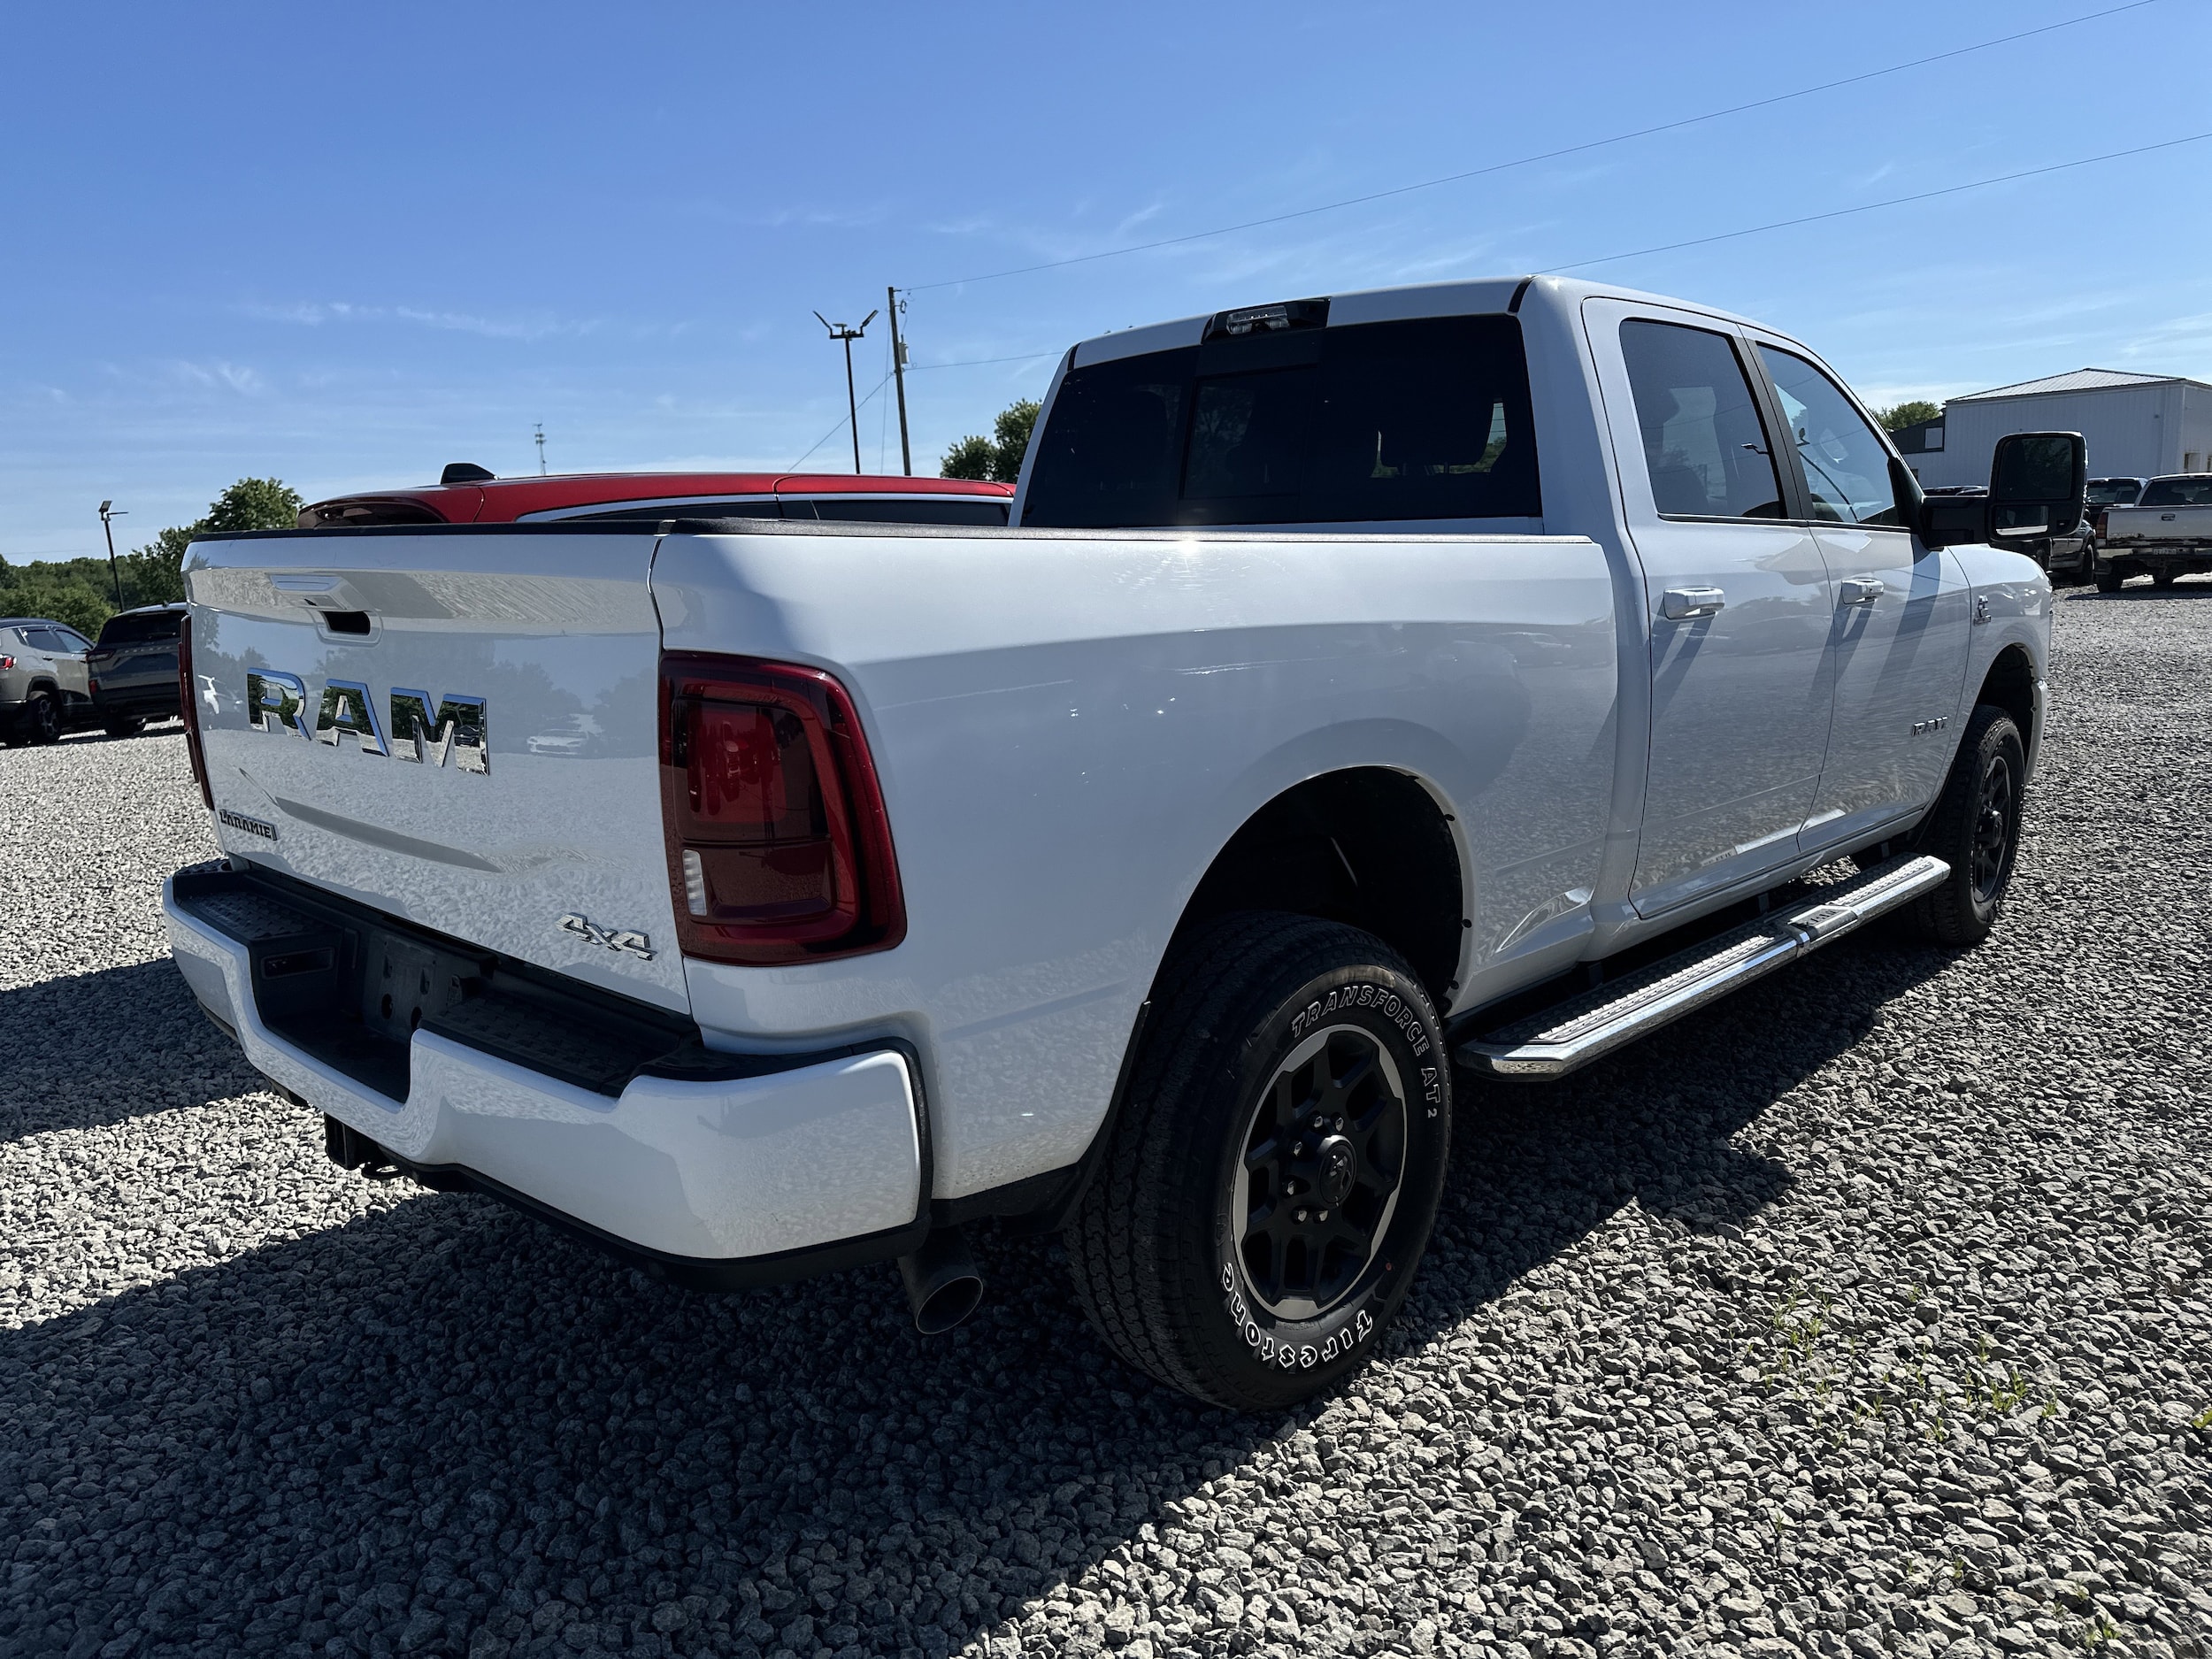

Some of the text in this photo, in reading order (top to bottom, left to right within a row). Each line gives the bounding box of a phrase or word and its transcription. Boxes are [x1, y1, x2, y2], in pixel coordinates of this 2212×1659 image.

[246, 667, 490, 776] RAM
[219, 809, 273, 840] LARAMIE
[1291, 985, 1430, 1056] TRANSFORCE
